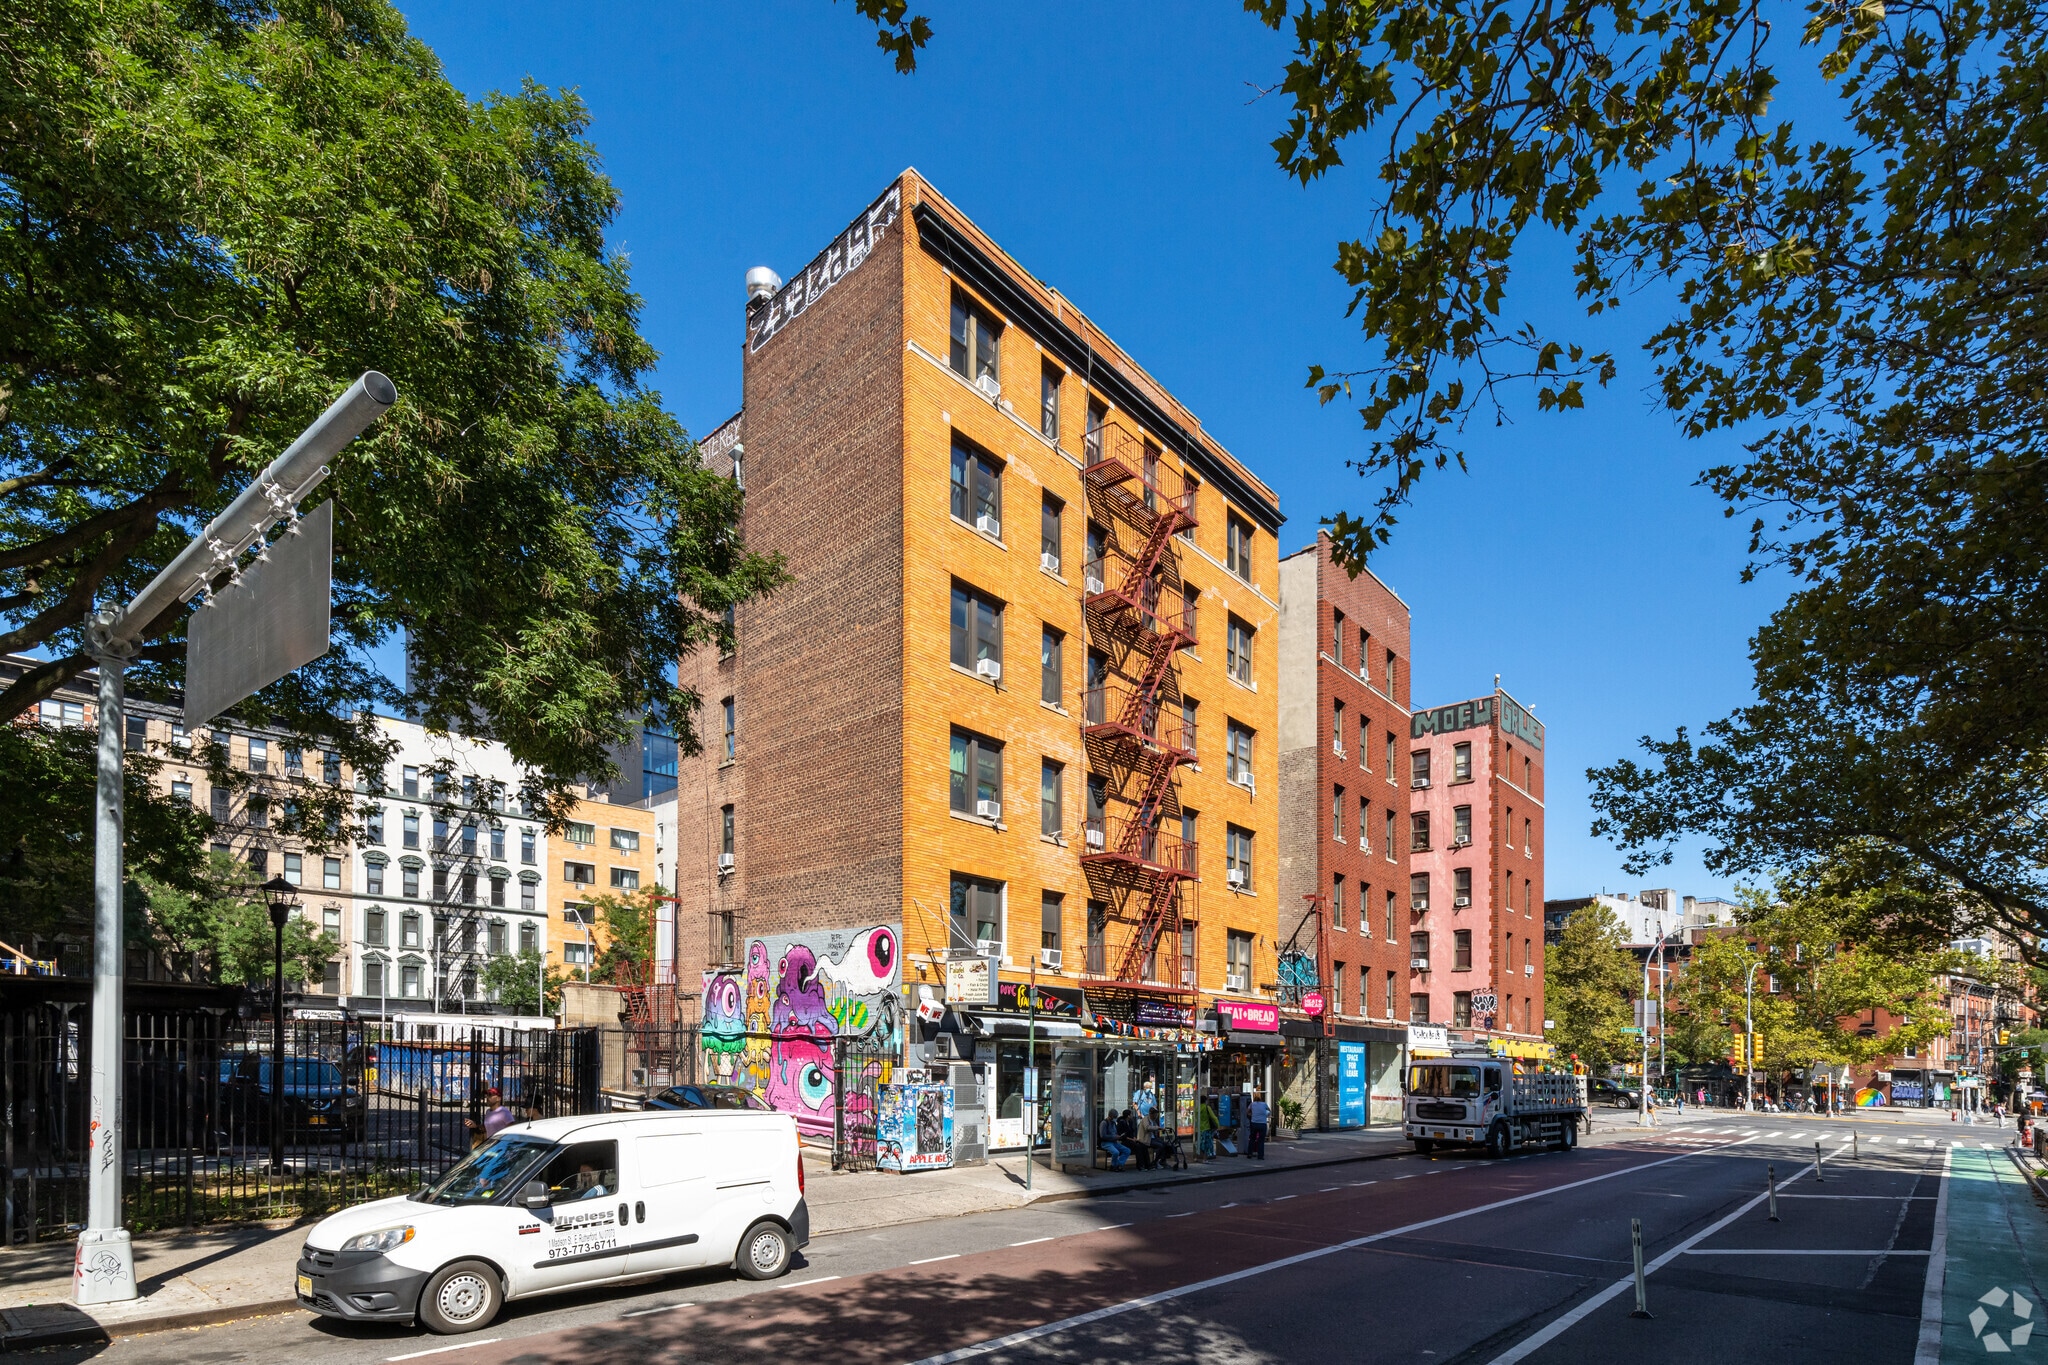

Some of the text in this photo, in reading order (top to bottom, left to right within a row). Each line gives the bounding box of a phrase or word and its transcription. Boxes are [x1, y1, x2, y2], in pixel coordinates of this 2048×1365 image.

[1000, 985, 1017, 997] NYC
[920, 1003, 930, 1016] WE
[932, 1010, 942, 1019] WE
[1340, 1045, 1364, 1054] RESTAURANT
[1346, 1054, 1359, 1062] SPACE
[1348, 1061, 1357, 1069] FOR
[1346, 1069, 1359, 1078] LEASE
[909, 1154, 933, 1164] APPLE
[550, 1210, 614, 1227] Wireless
[548, 1238, 617, 1259] 973-773-6711
